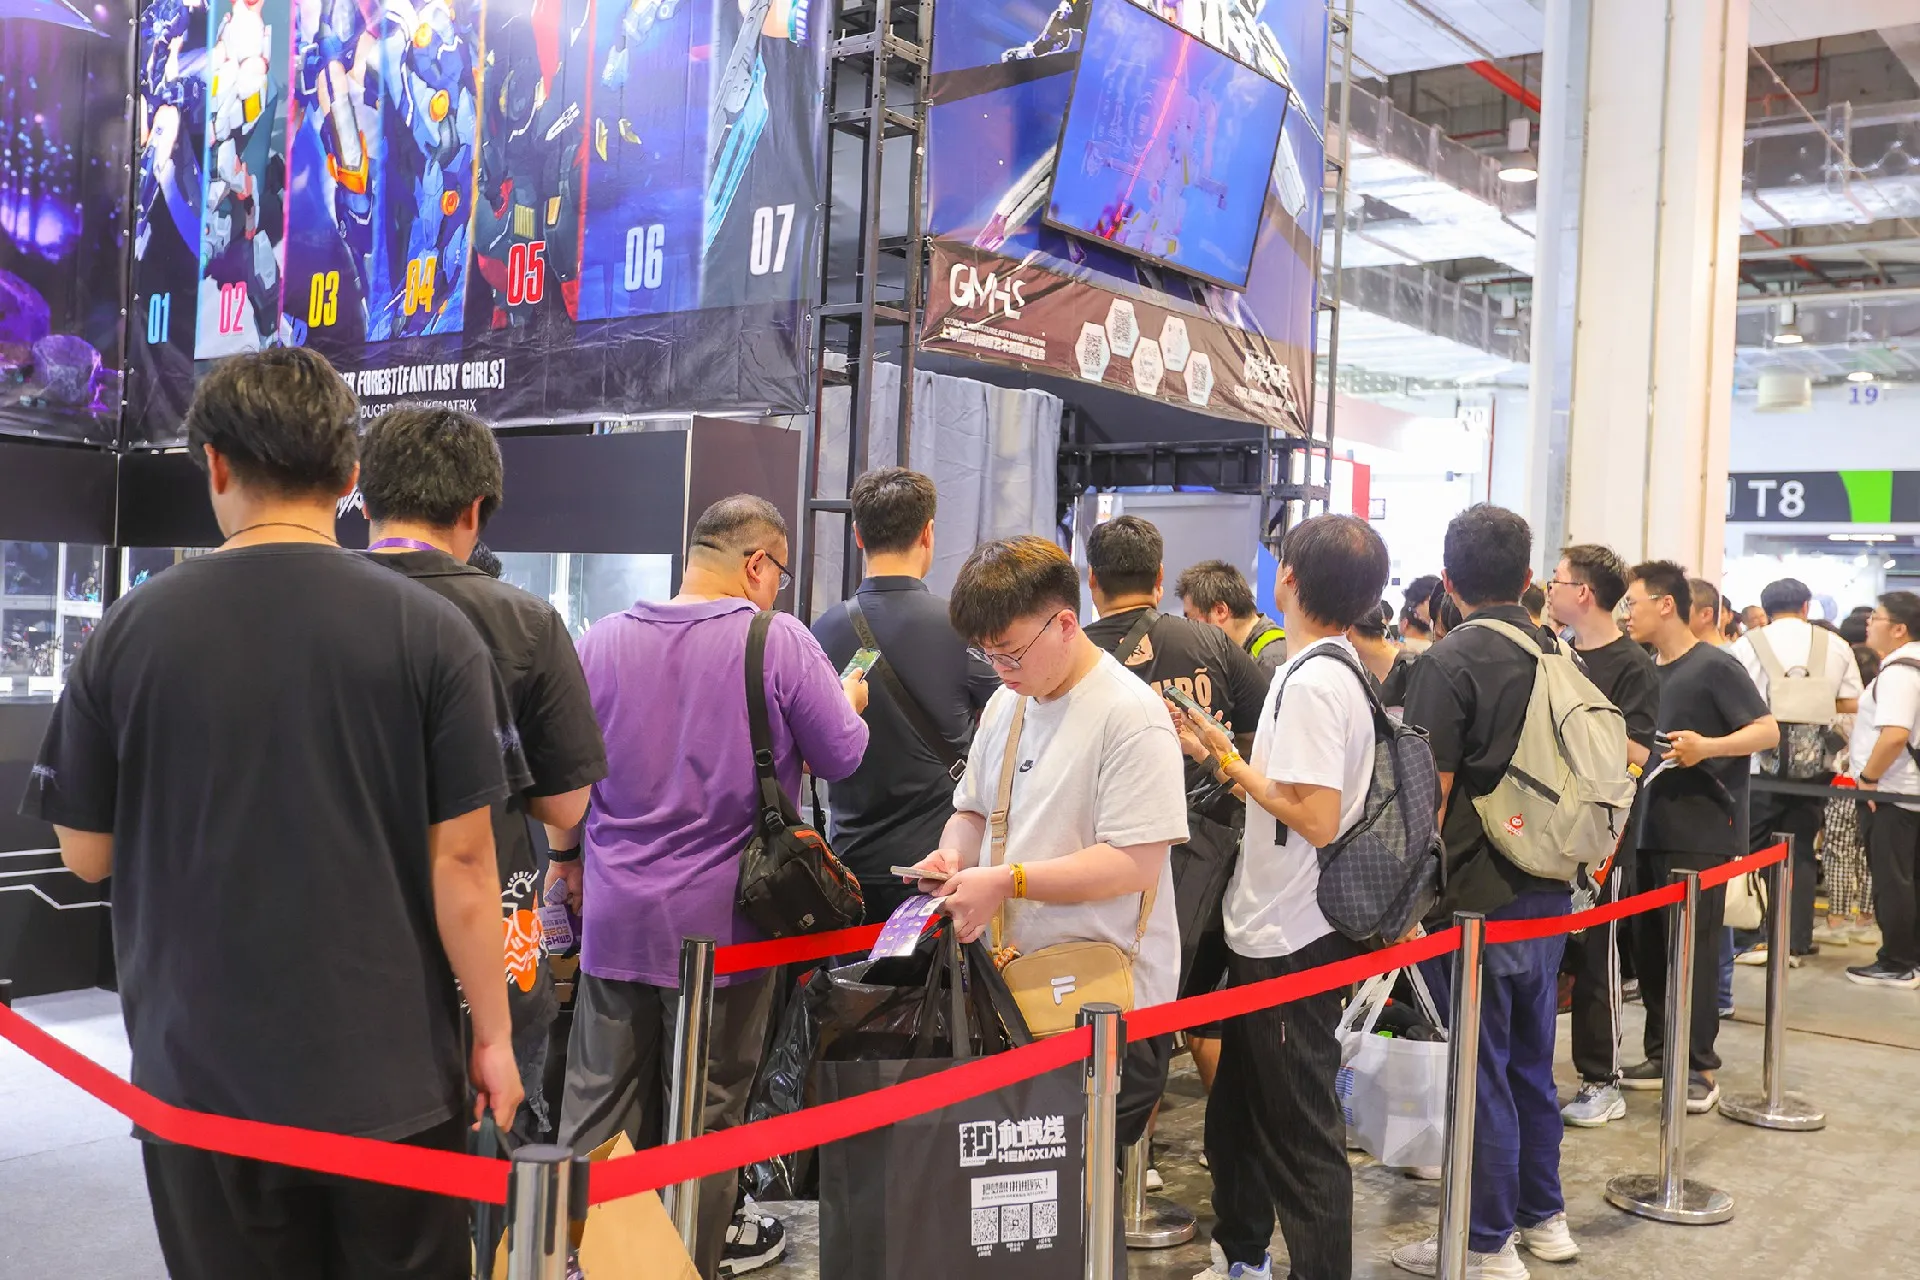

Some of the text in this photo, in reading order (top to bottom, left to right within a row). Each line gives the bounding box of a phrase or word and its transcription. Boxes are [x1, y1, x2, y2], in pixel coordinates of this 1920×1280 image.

[624, 223, 665, 292] 06
[750, 203, 796, 275] 07
[307, 270, 339, 328] 03
[403, 255, 436, 316] 04
[506, 240, 547, 306] 05
[147, 293, 171, 343] 01
[218, 280, 249, 335] 02
[461, 358, 506, 390] GIRLS]
[1848, 386, 1879, 406] 19
[1747, 479, 1806, 518] T8
[997, 1145, 1067, 1163] HEMOXIAN
